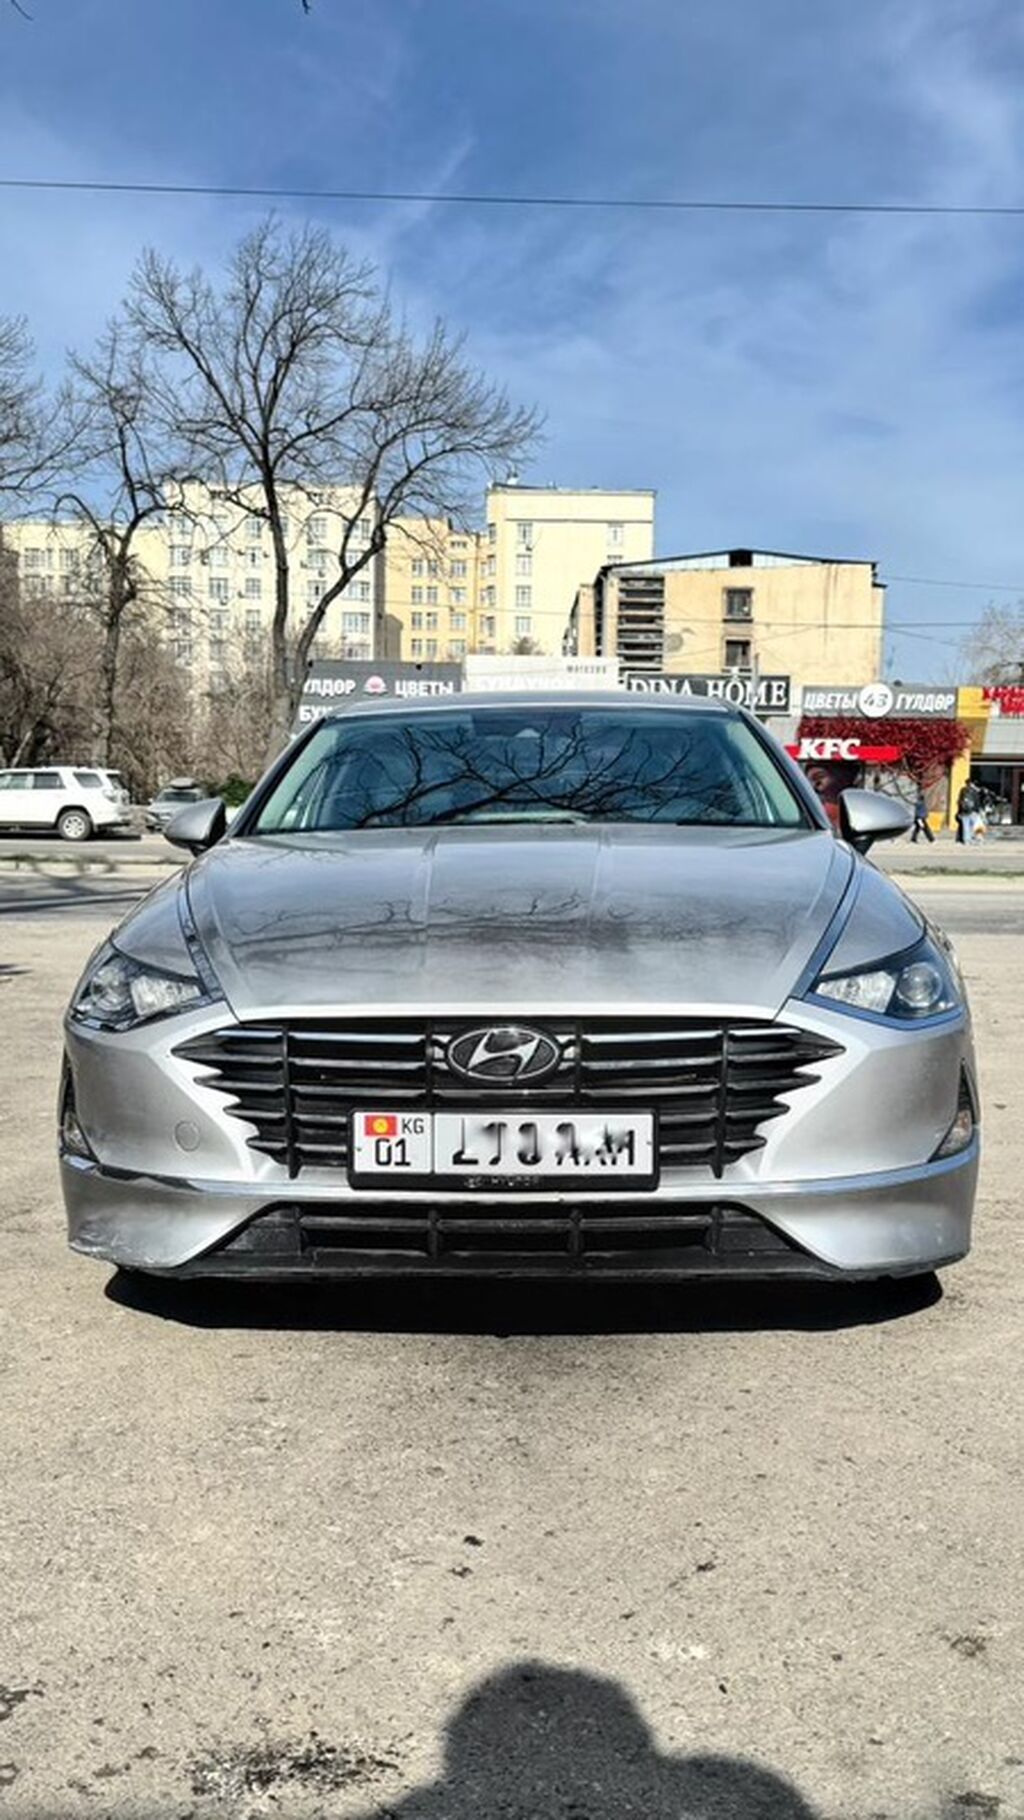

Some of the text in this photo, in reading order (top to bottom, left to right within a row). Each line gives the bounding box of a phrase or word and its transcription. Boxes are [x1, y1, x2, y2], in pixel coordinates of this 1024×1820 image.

[395, 679, 454, 698] ЦВЕТЫ
[630, 679, 788, 707] DINA HOME
[804, 692, 858, 711] ЦВЕТЫ
[797, 738, 860, 760] KFC
[401, 1117, 425, 1134] KG
[374, 1138, 412, 1167] 01
